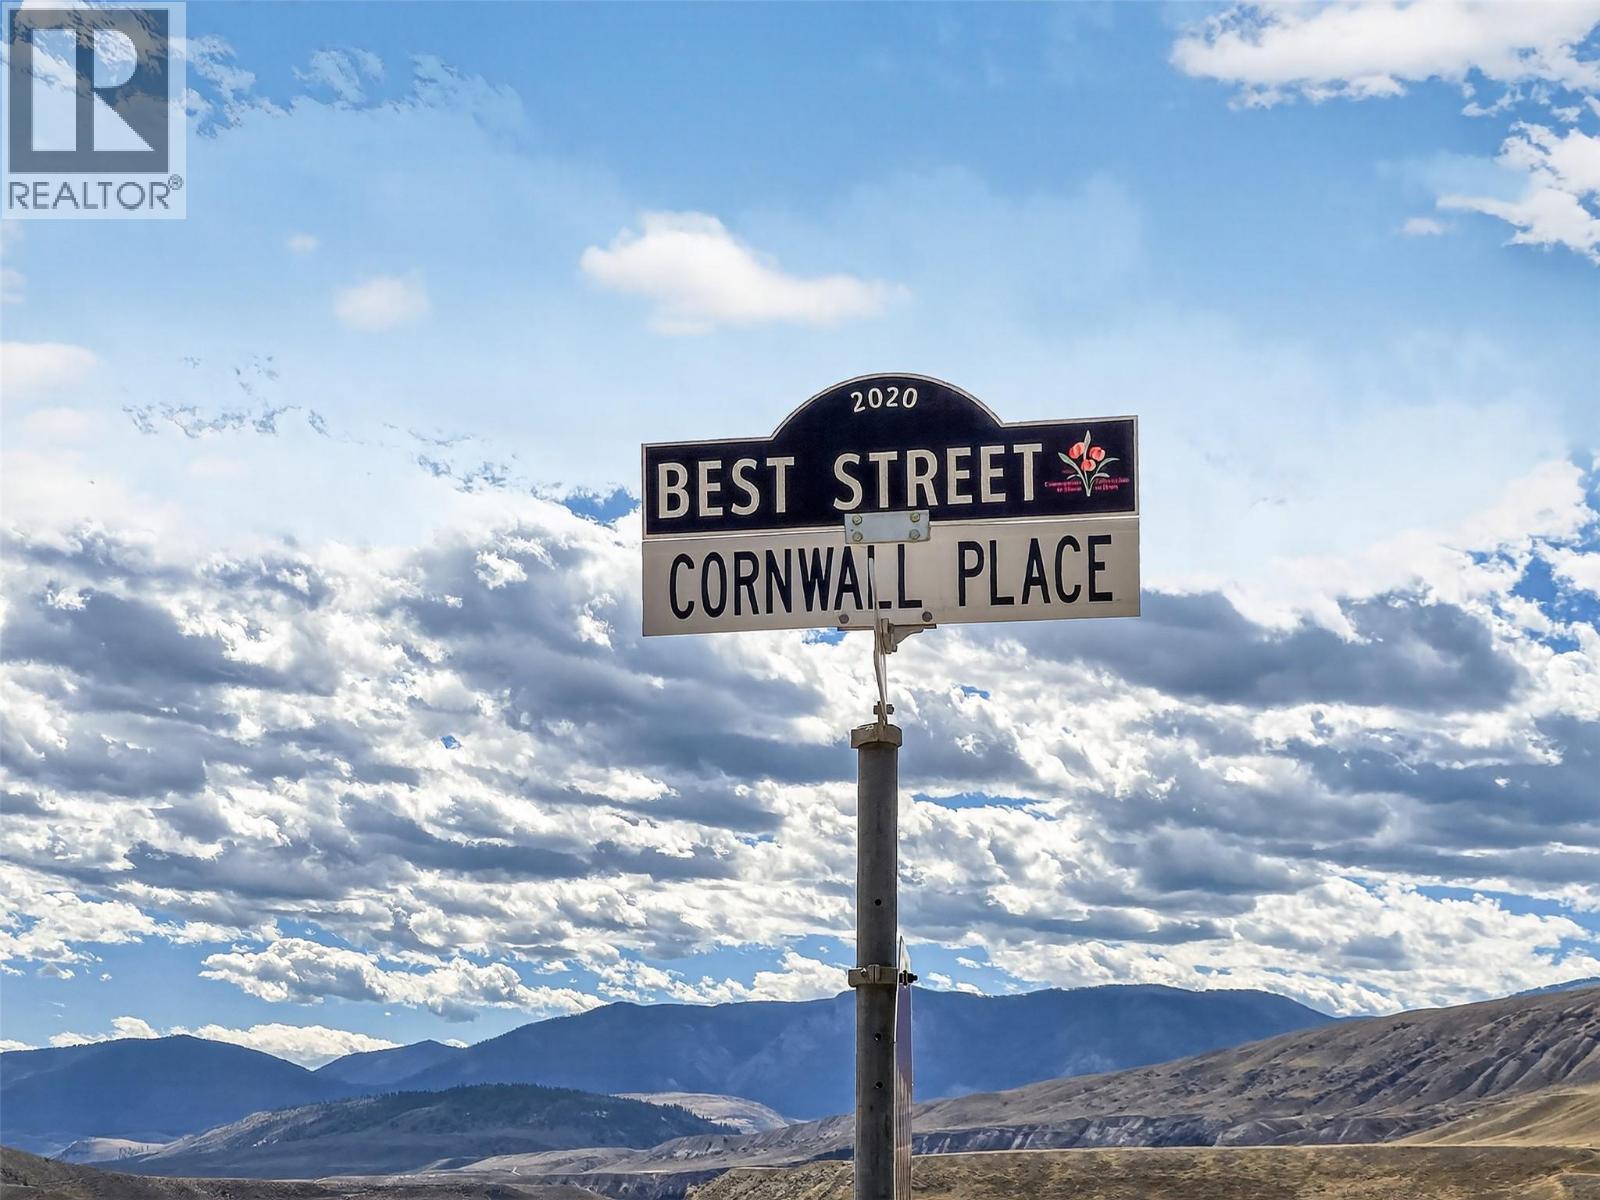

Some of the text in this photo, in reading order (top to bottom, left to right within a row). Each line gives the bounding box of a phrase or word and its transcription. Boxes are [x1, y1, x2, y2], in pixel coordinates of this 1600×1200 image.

[850, 386, 918, 413] 2020
[657, 443, 1043, 519] BEST STREET
[669, 535, 1113, 620] CORNWALL PLACE
